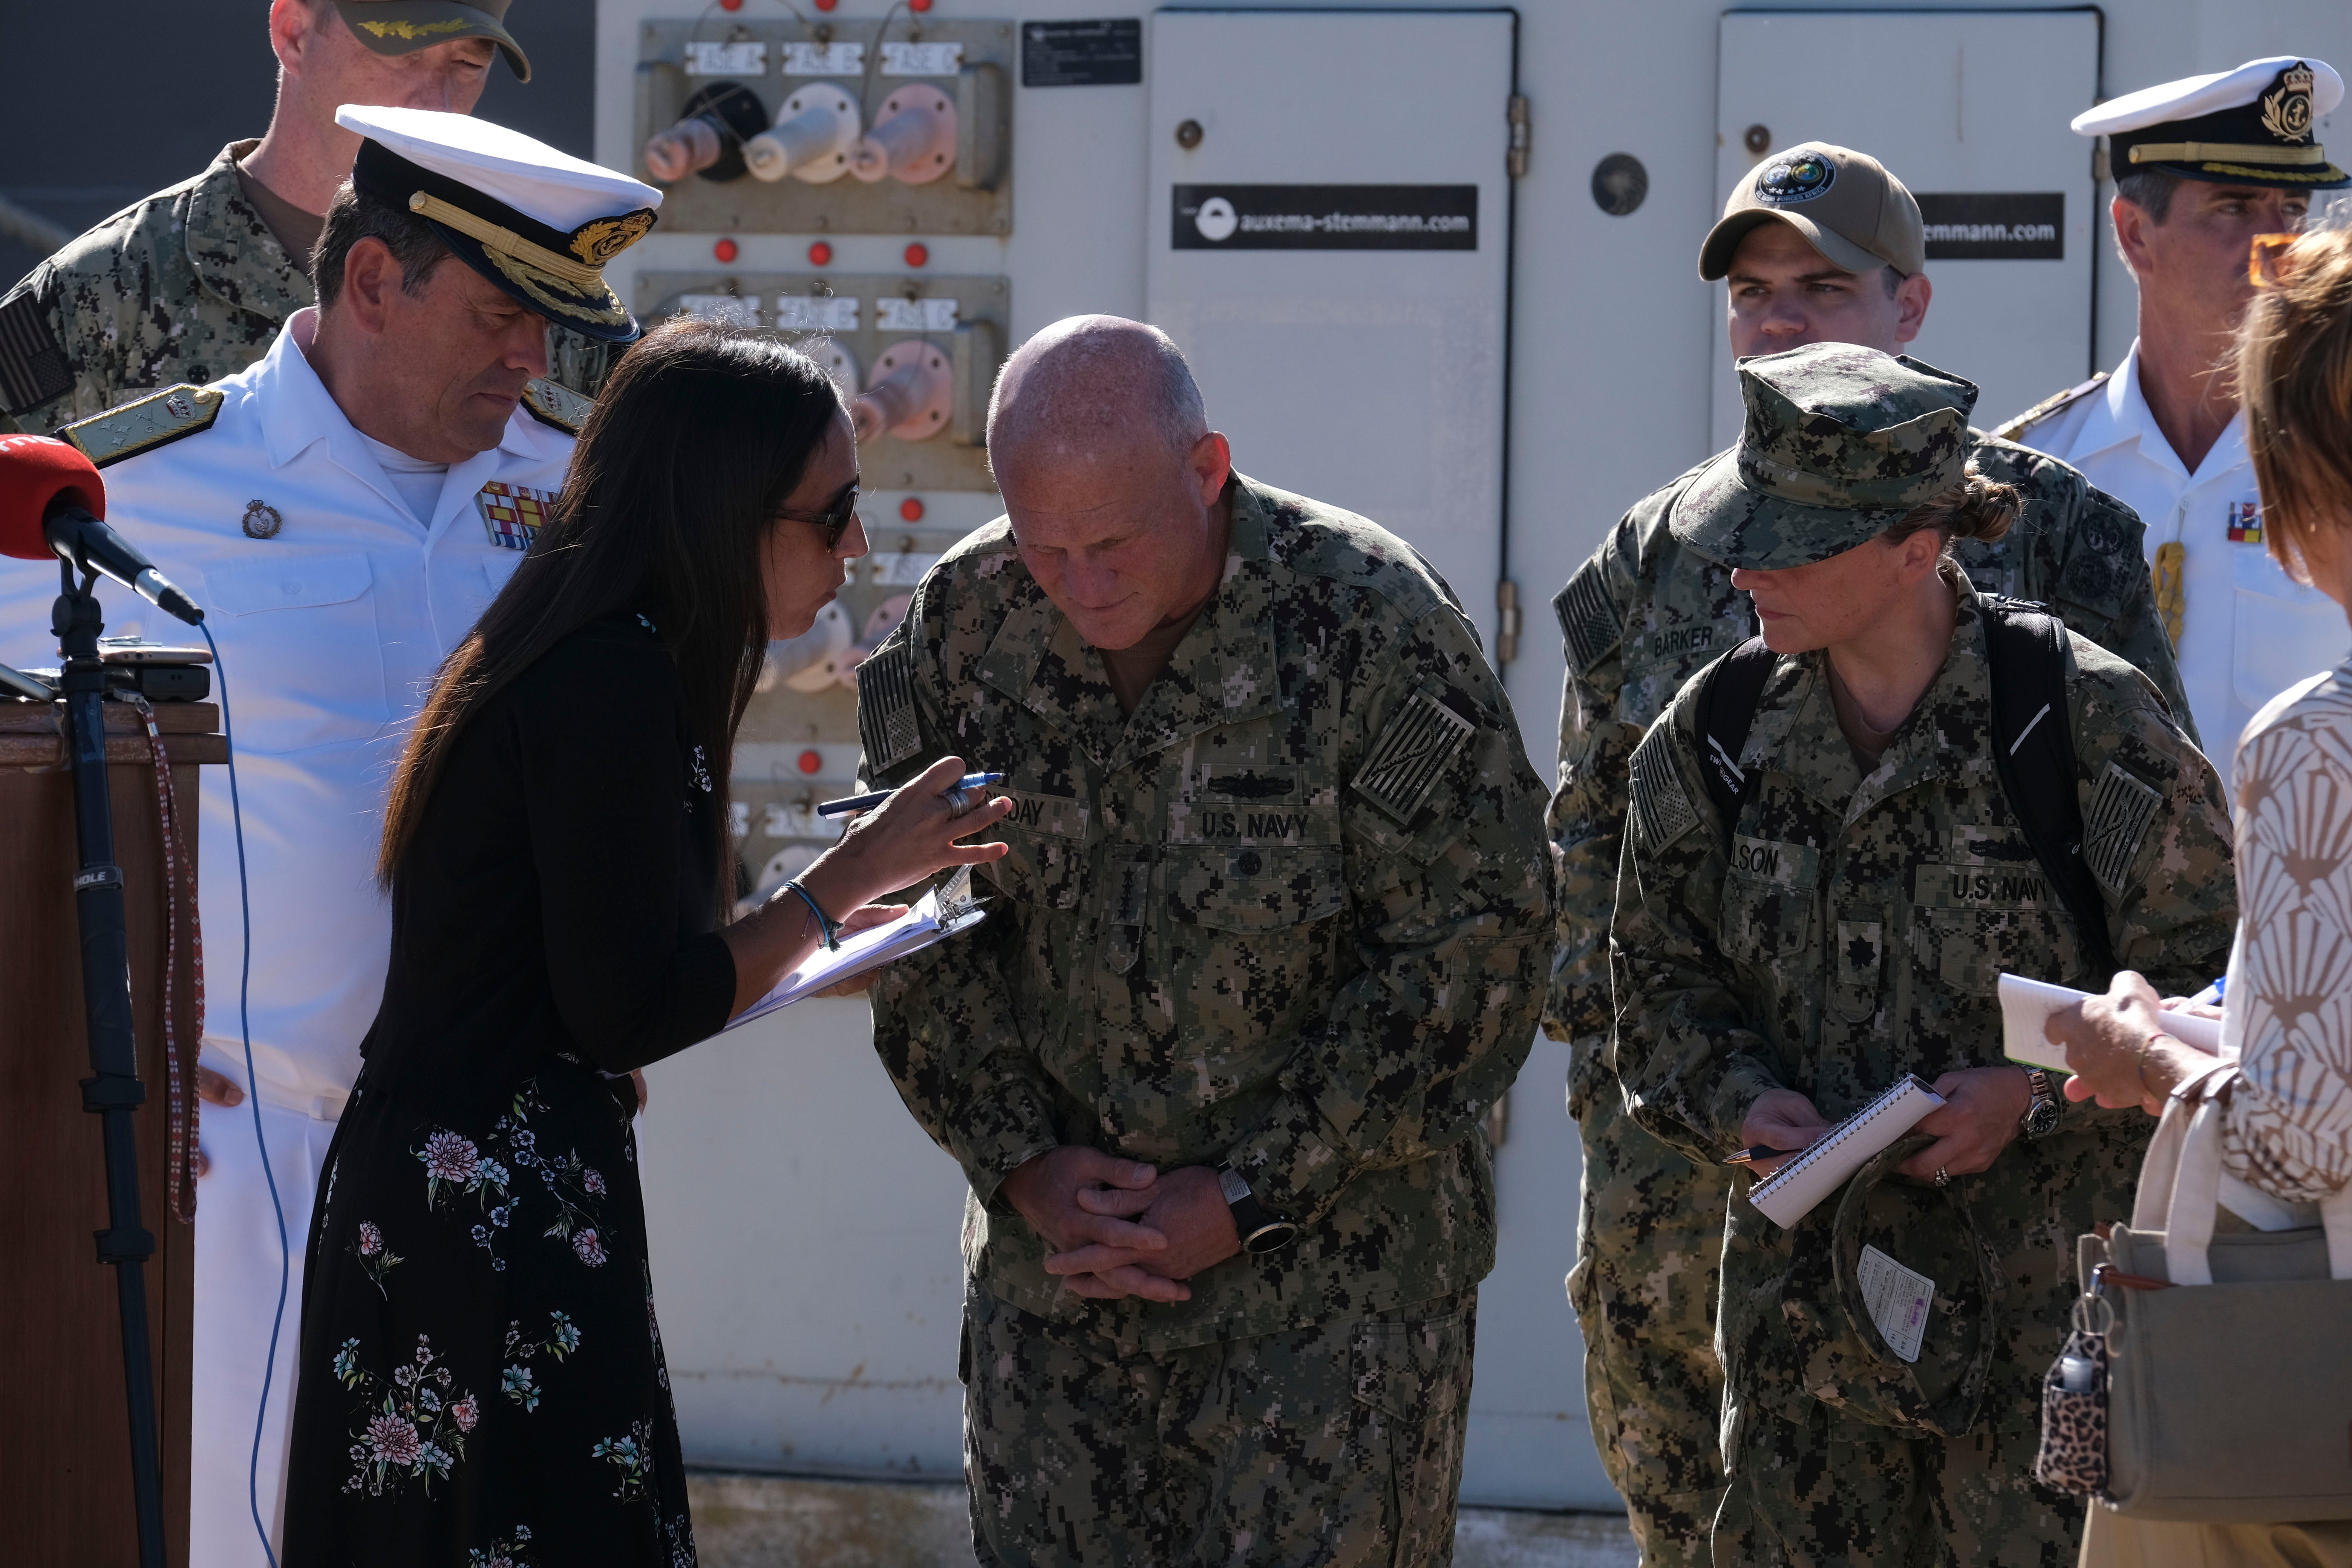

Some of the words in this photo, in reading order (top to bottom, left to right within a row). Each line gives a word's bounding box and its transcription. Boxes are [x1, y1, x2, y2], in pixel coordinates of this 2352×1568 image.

[1655, 626, 1713, 658] BARKER
[1203, 812, 1241, 837] U.S.
[1248, 813, 1309, 838] NAVY
[1954, 874, 1995, 900] U.S.
[2002, 877, 2047, 901] NAVY
